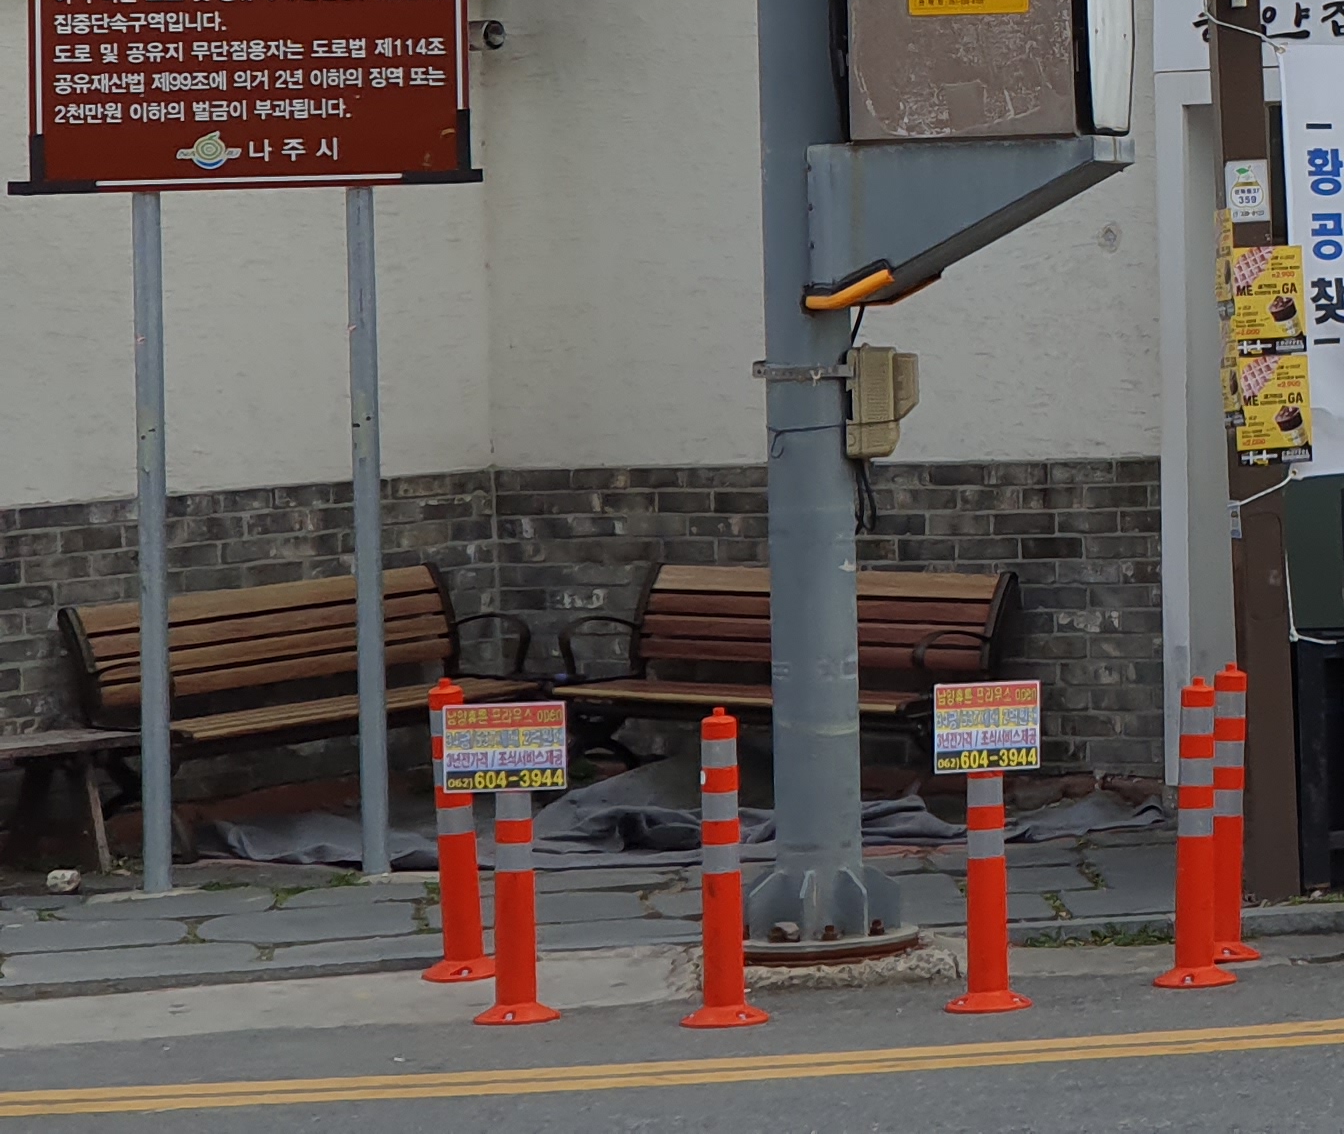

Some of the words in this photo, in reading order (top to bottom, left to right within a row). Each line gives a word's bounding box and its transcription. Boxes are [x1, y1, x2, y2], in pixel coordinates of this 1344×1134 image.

[54, 11, 228, 35] 집중단속구역입니다.
[53, 44, 93, 63] 도로
[100, 43, 118, 63] 및
[126, 41, 184, 63] 공유지
[191, 39, 305, 61] 무단점용자는
[310, 38, 366, 58] 도로법
[374, 37, 447, 58] 제114조
[53, 73, 145, 94] 공유재산법
[151, 70, 227, 92] 제99조에
[233, 69, 269, 90] 의거
[275, 69, 304, 89] 2년
[310, 67, 363, 88] 이하의
[369, 66, 404, 87] 징역
[409, 66, 446, 85] 또는
[54, 103, 123, 124] 2천만원
[130, 100, 186, 122] 이하의
[192, 99, 247, 121] 벌금이
[254, 97, 352, 119] 부과됩니다.
[1281, 283, 1298, 294] GA
[1287, 392, 1304, 404] GA
[938, 748, 1037, 770] 062)604-3944
[447, 769, 564, 789] 062)604-3944
